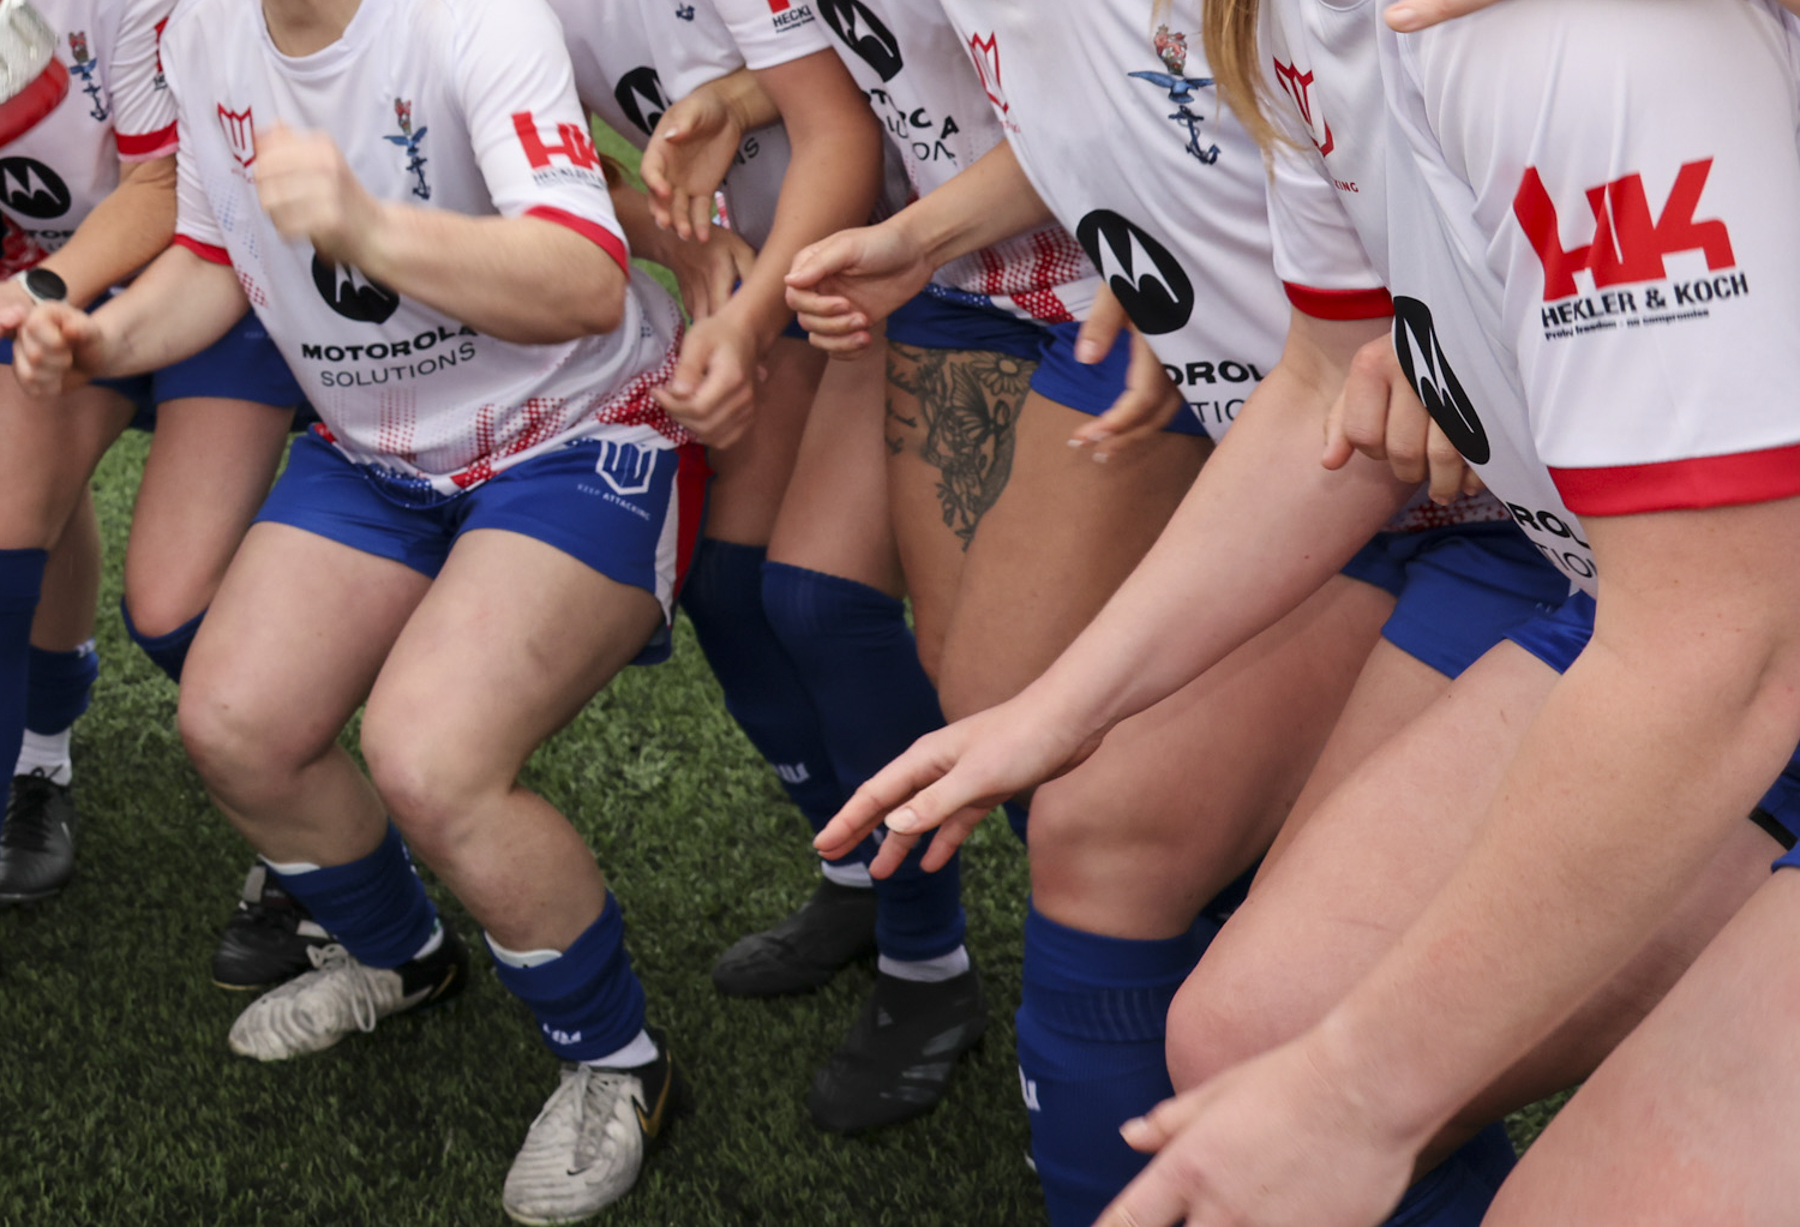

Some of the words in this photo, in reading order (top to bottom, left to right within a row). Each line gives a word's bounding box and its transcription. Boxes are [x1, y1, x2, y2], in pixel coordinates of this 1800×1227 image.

[1513, 156, 1736, 302] HK
[1646, 287, 1666, 309] &
[1674, 272, 1749, 306] KOCH
[301, 326, 479, 363] MOTOROLA
[320, 341, 477, 388] SOLUTIONS
